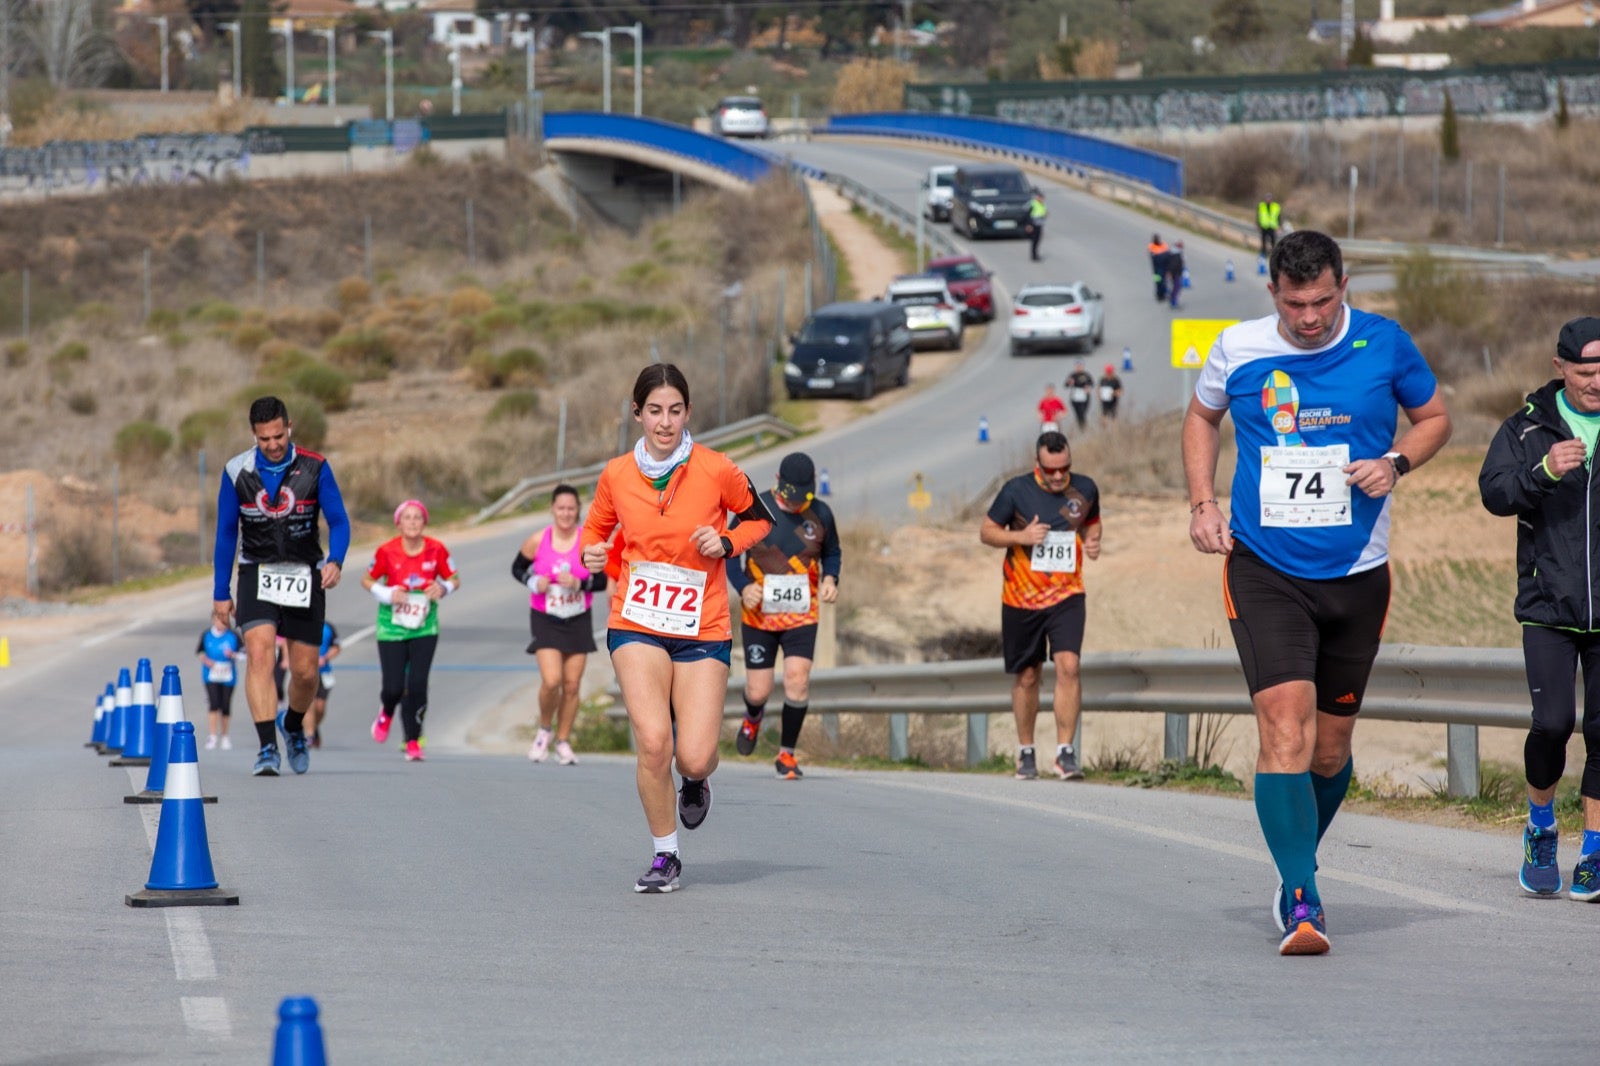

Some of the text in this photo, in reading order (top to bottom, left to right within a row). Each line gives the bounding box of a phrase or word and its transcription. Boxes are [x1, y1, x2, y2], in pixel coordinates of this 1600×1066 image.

[1277, 416, 1292, 427] 39
[1299, 414, 1351, 427] SAN ANTÓN
[1286, 473, 1324, 499] 74
[1036, 544, 1072, 560] 3181
[262, 574, 308, 593] 3170
[631, 578, 699, 612] 2172
[773, 588, 803, 603] 548
